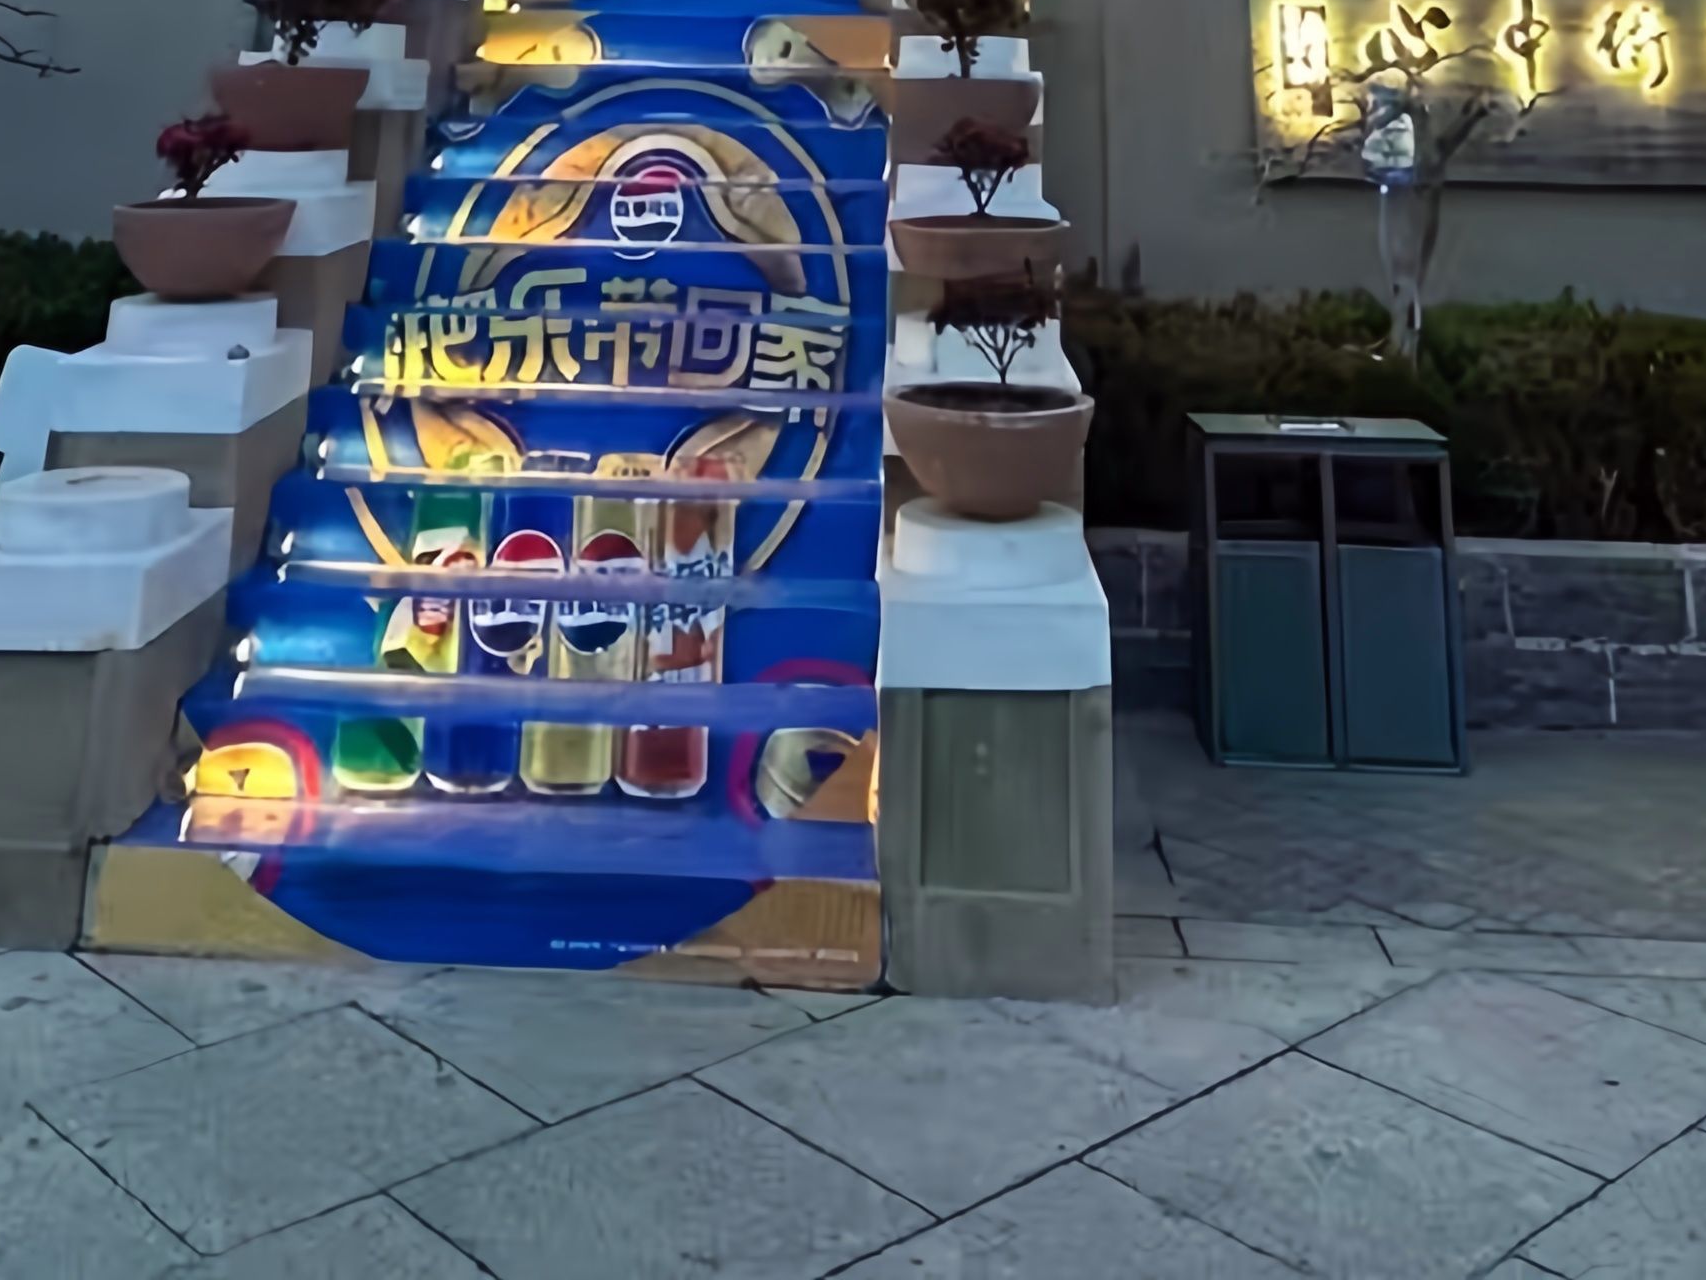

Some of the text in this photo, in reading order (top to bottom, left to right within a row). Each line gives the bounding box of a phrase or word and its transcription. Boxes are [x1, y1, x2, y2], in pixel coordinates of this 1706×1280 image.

[385, 268, 850, 425] 把乐带回家
